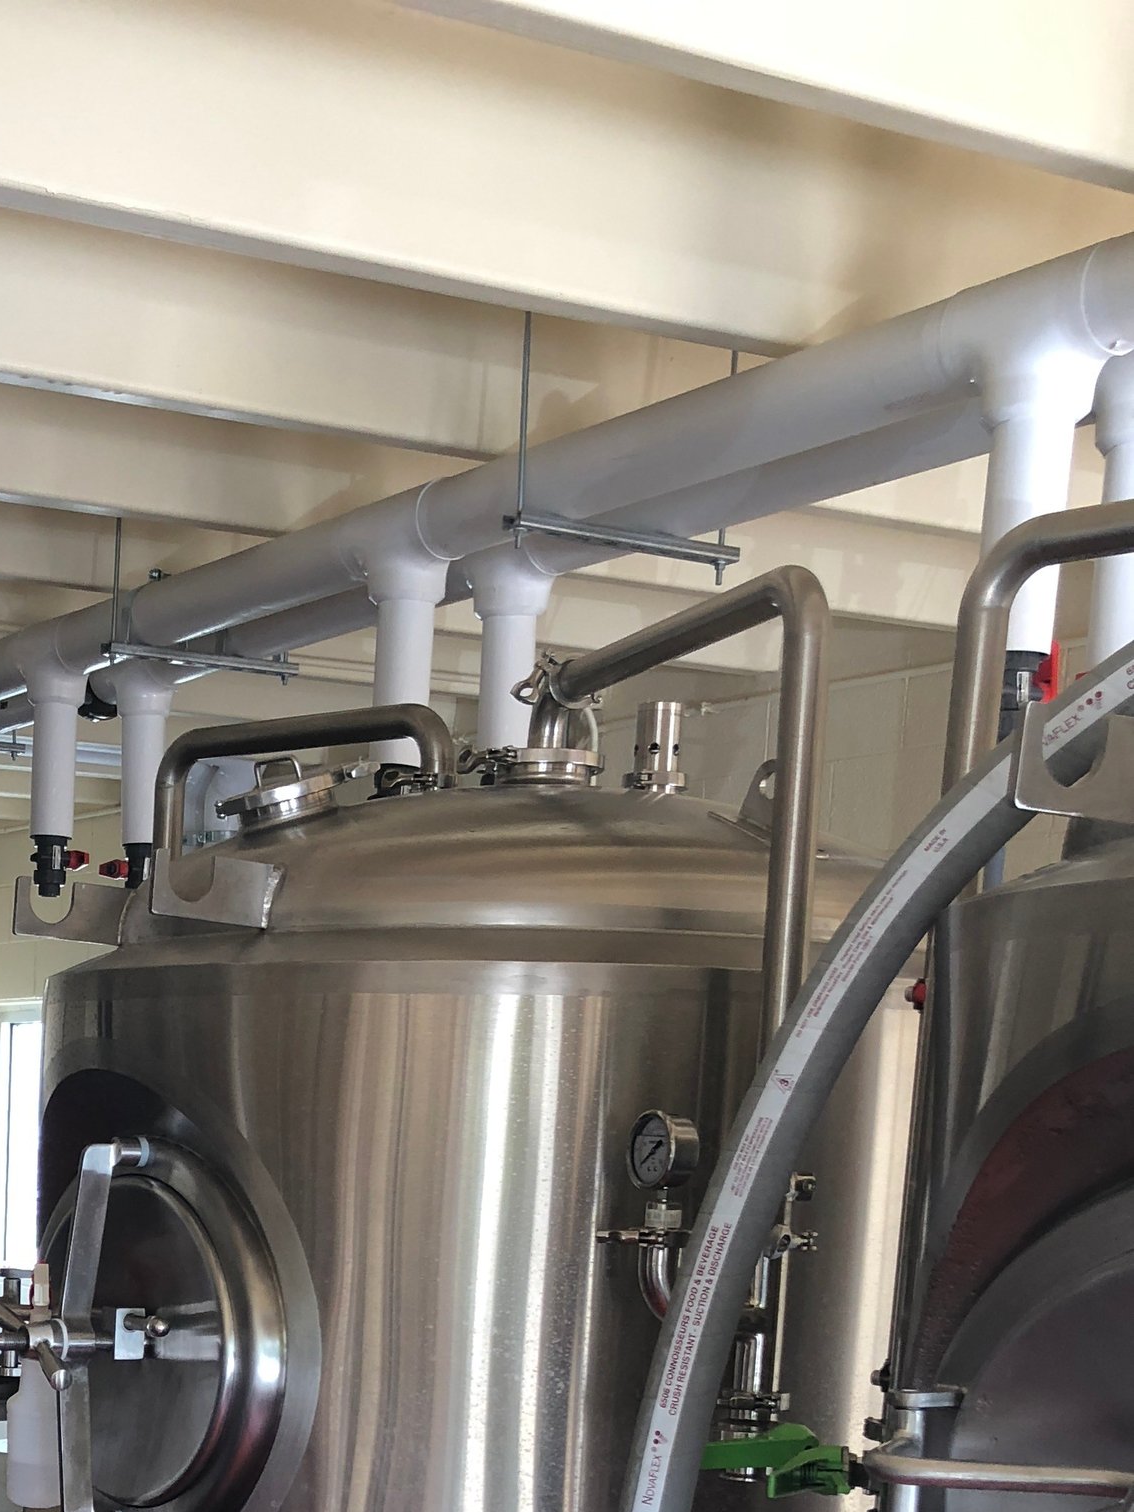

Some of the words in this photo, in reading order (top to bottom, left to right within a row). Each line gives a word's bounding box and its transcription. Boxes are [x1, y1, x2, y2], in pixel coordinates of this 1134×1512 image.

[708, 1222, 733, 1276] DISCHARGE
[707, 1278, 713, 1286] &
[665, 1314, 690, 1386] CONNOISSEURS
[686, 1286, 697, 1313] FOOD
[697, 1226, 719, 1277] BEVERAGE
[693, 1286, 710, 1326] SUCTION
[677, 1334, 696, 1382] RESISTANT
[669, 1382, 683, 1415] CRUSH
